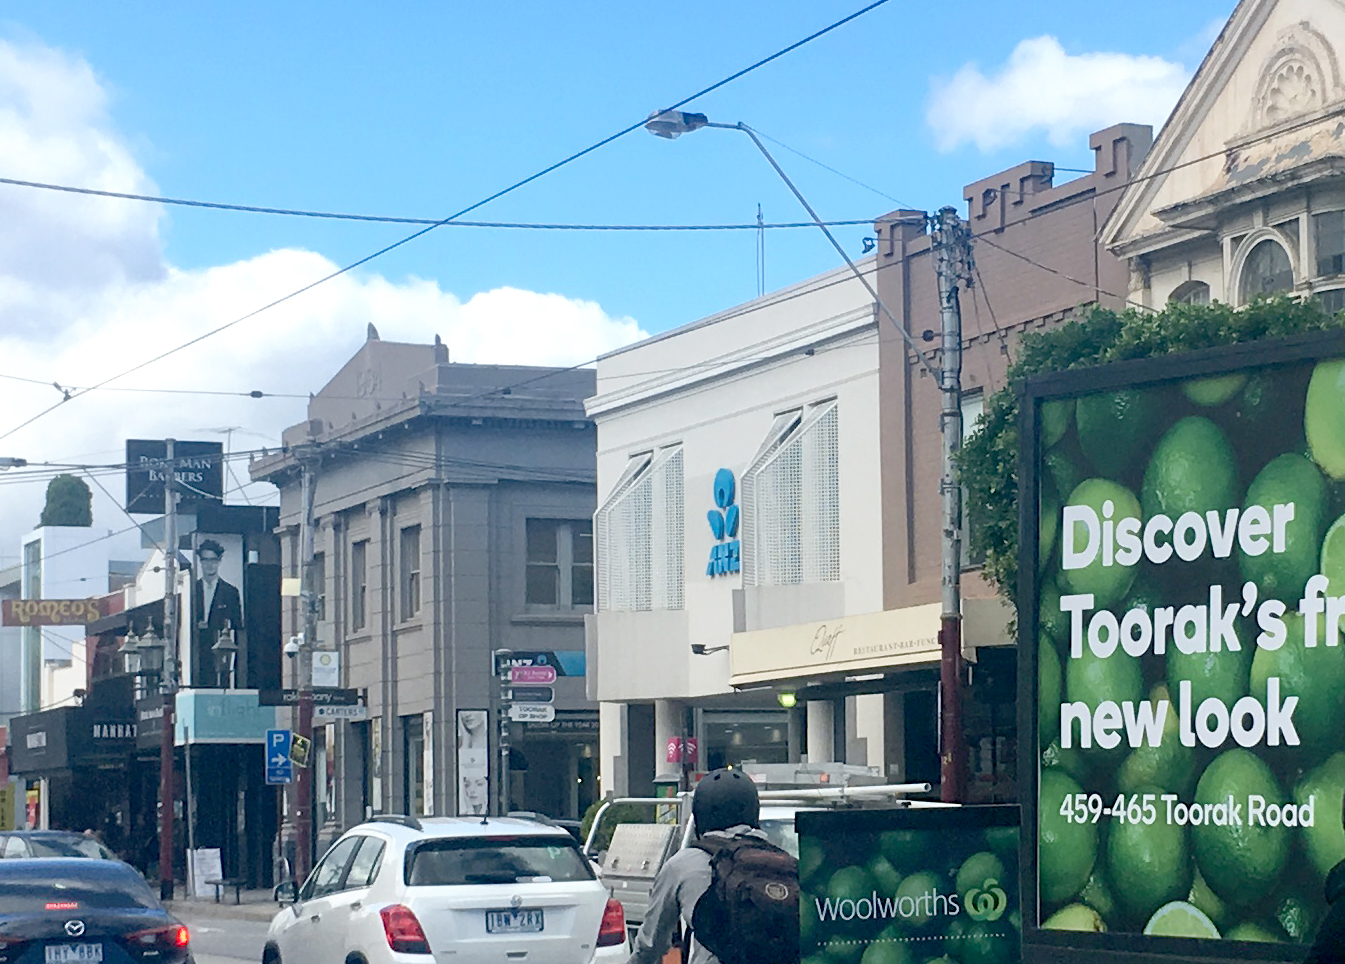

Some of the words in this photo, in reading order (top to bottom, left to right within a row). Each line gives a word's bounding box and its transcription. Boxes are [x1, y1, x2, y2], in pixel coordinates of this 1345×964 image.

[149, 470, 203, 482] BABERS
[1062, 500, 1295, 570] Discover
[1060, 582, 1287, 660] Toorak's
[1060, 699, 1169, 749] new
[1179, 677, 1300, 748] look
[273, 734, 284, 747] P
[1059, 793, 1156, 825] 459-465
[1161, 794, 1243, 827] Toorak
[1248, 794, 1315, 828] Road
[815, 888, 960, 922] Woolworths
